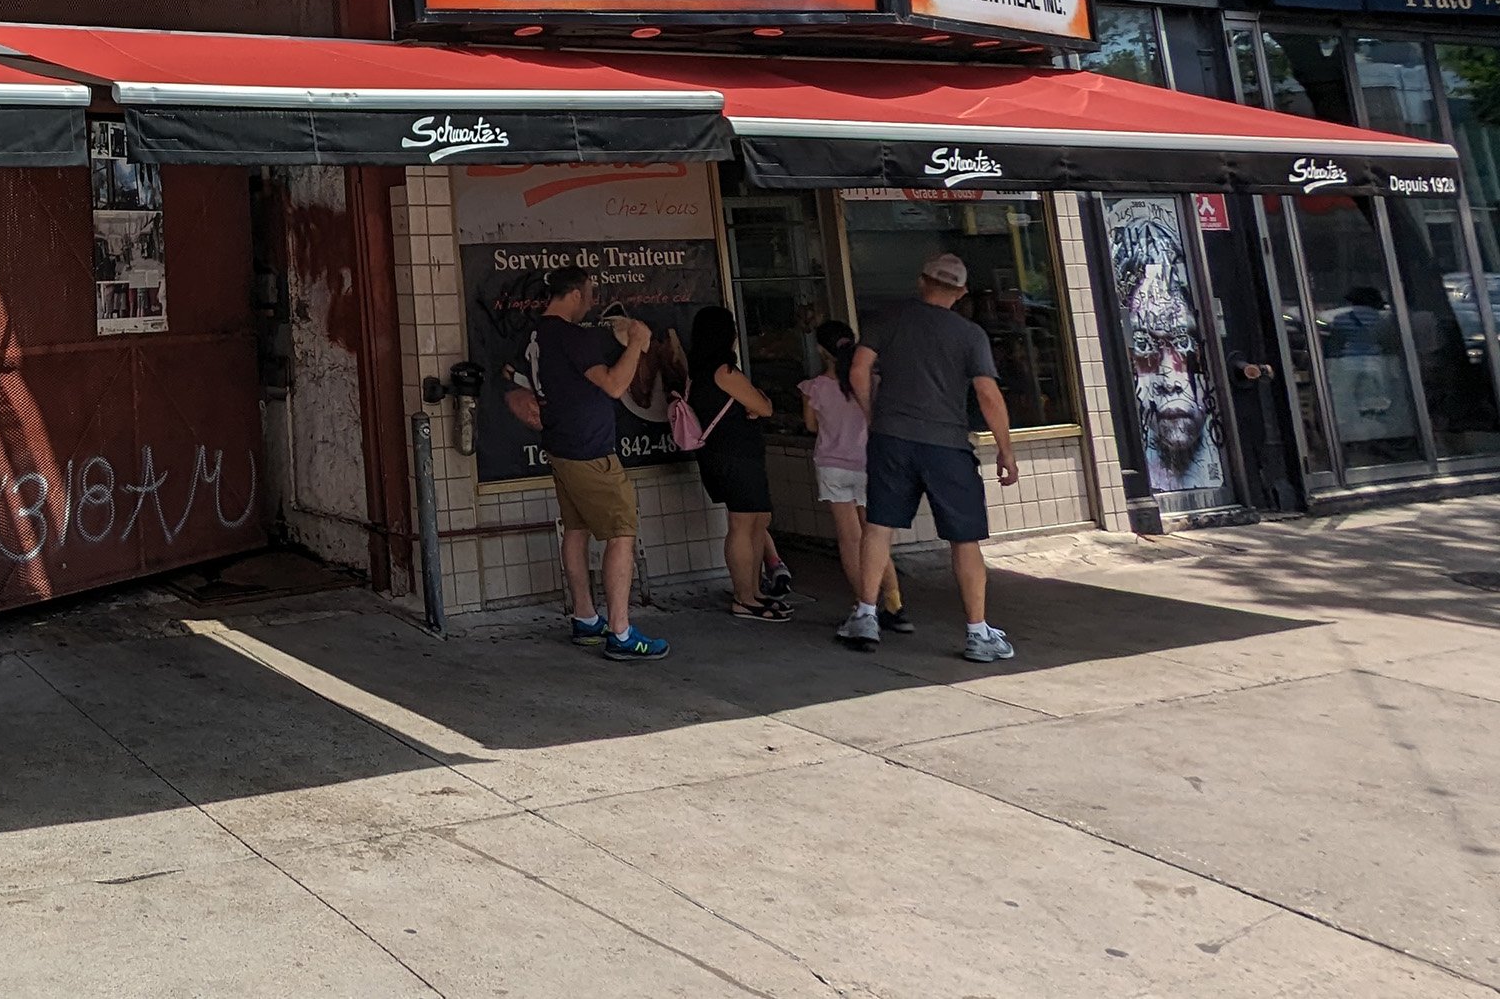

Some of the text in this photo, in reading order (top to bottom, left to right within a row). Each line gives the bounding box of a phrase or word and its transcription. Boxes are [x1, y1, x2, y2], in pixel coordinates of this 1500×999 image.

[402, 116, 510, 163] Schwartz's
[924, 147, 1002, 188] Schwartz's
[1289, 158, 1348, 194] Schwartz's
[1390, 175, 1428, 195] Depuis
[606, 194, 700, 216] Chez Vous
[494, 246, 686, 271] Service de Traiteur
[601, 270, 645, 285] Service
